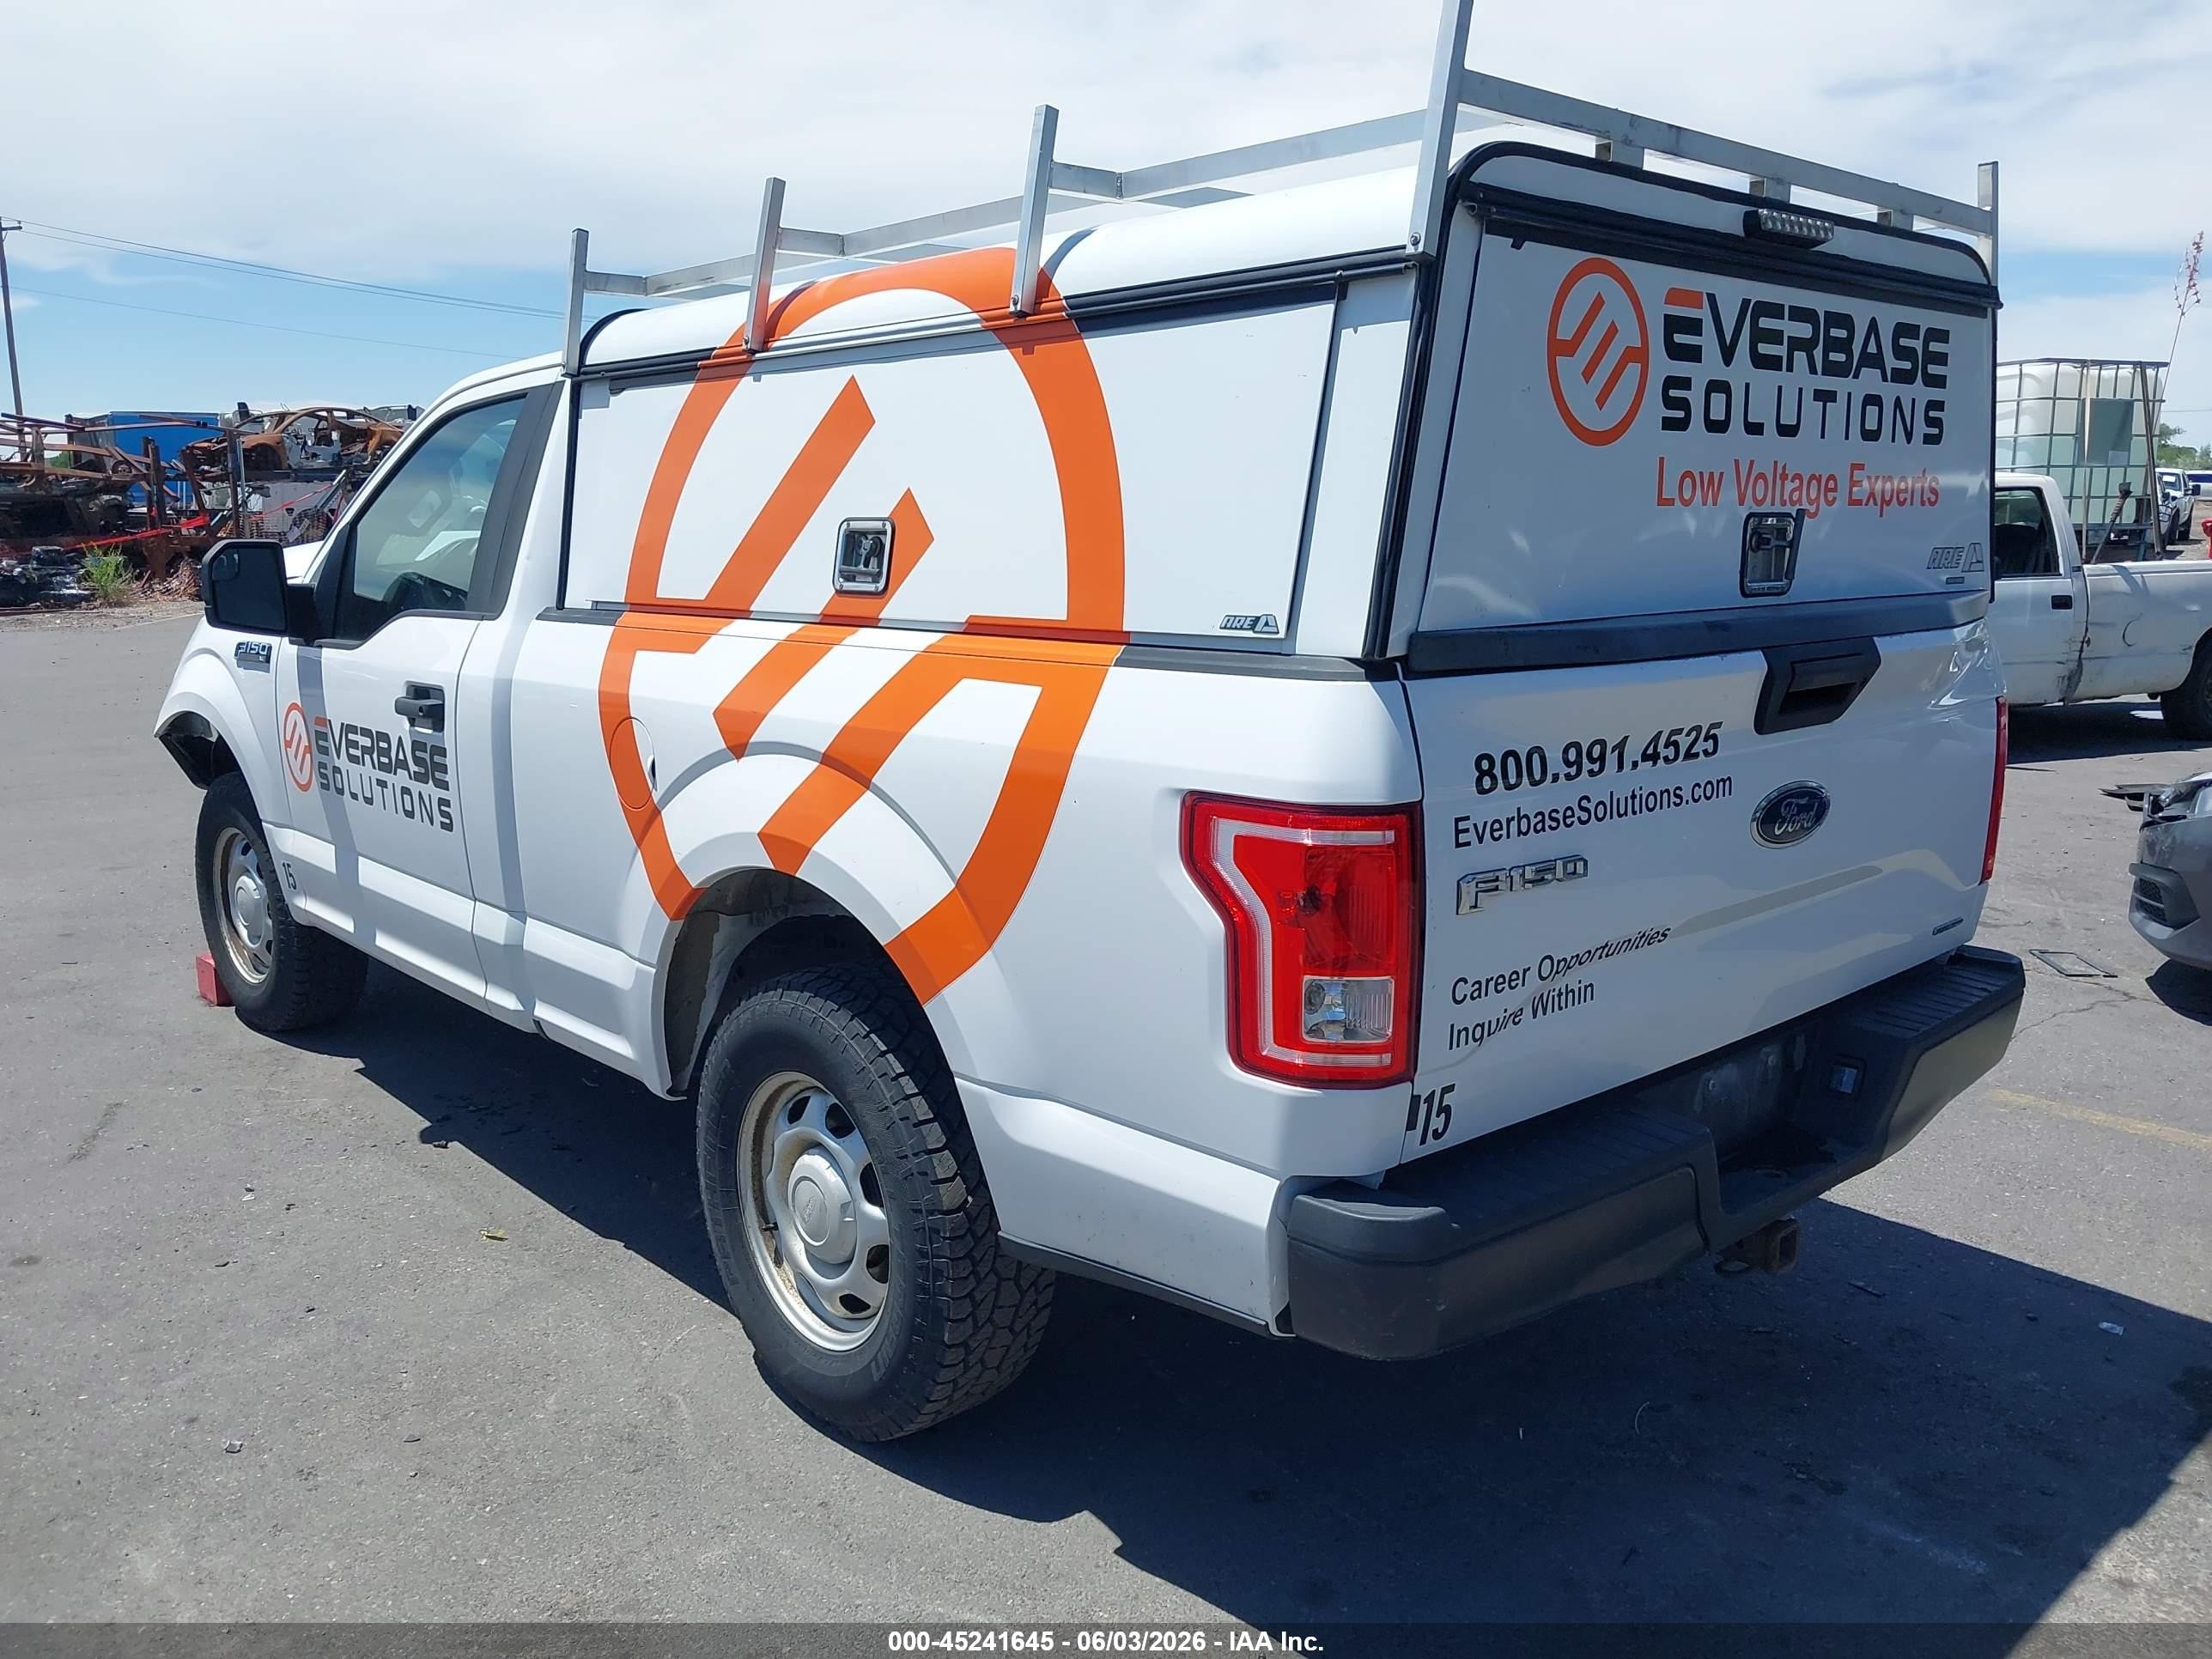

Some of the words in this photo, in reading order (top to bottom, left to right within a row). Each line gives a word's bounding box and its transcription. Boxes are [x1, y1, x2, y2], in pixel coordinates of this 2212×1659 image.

[1662, 287, 1950, 389] EVERBASE
[1661, 374, 1945, 446] SOLUTIONS
[1656, 456, 1723, 507] Low
[1734, 459, 1838, 520] Voltage
[1847, 462, 1939, 518] Experts
[314, 716, 450, 792] EVERBASE
[1474, 721, 1724, 795] 800.991.4525
[318, 762, 453, 832] SOLUTIONS
[1454, 775, 1733, 849] EverbaseSolutions.com
[1774, 796, 1819, 836] Ford
[282, 861, 297, 890] 15
[1451, 964, 1531, 1006] Career
[1536, 926, 1671, 984] Opportunities
[1448, 1007, 1523, 1051] Inquire
[1530, 981, 1595, 1019] Within
[1419, 1083, 1455, 1146] 15
